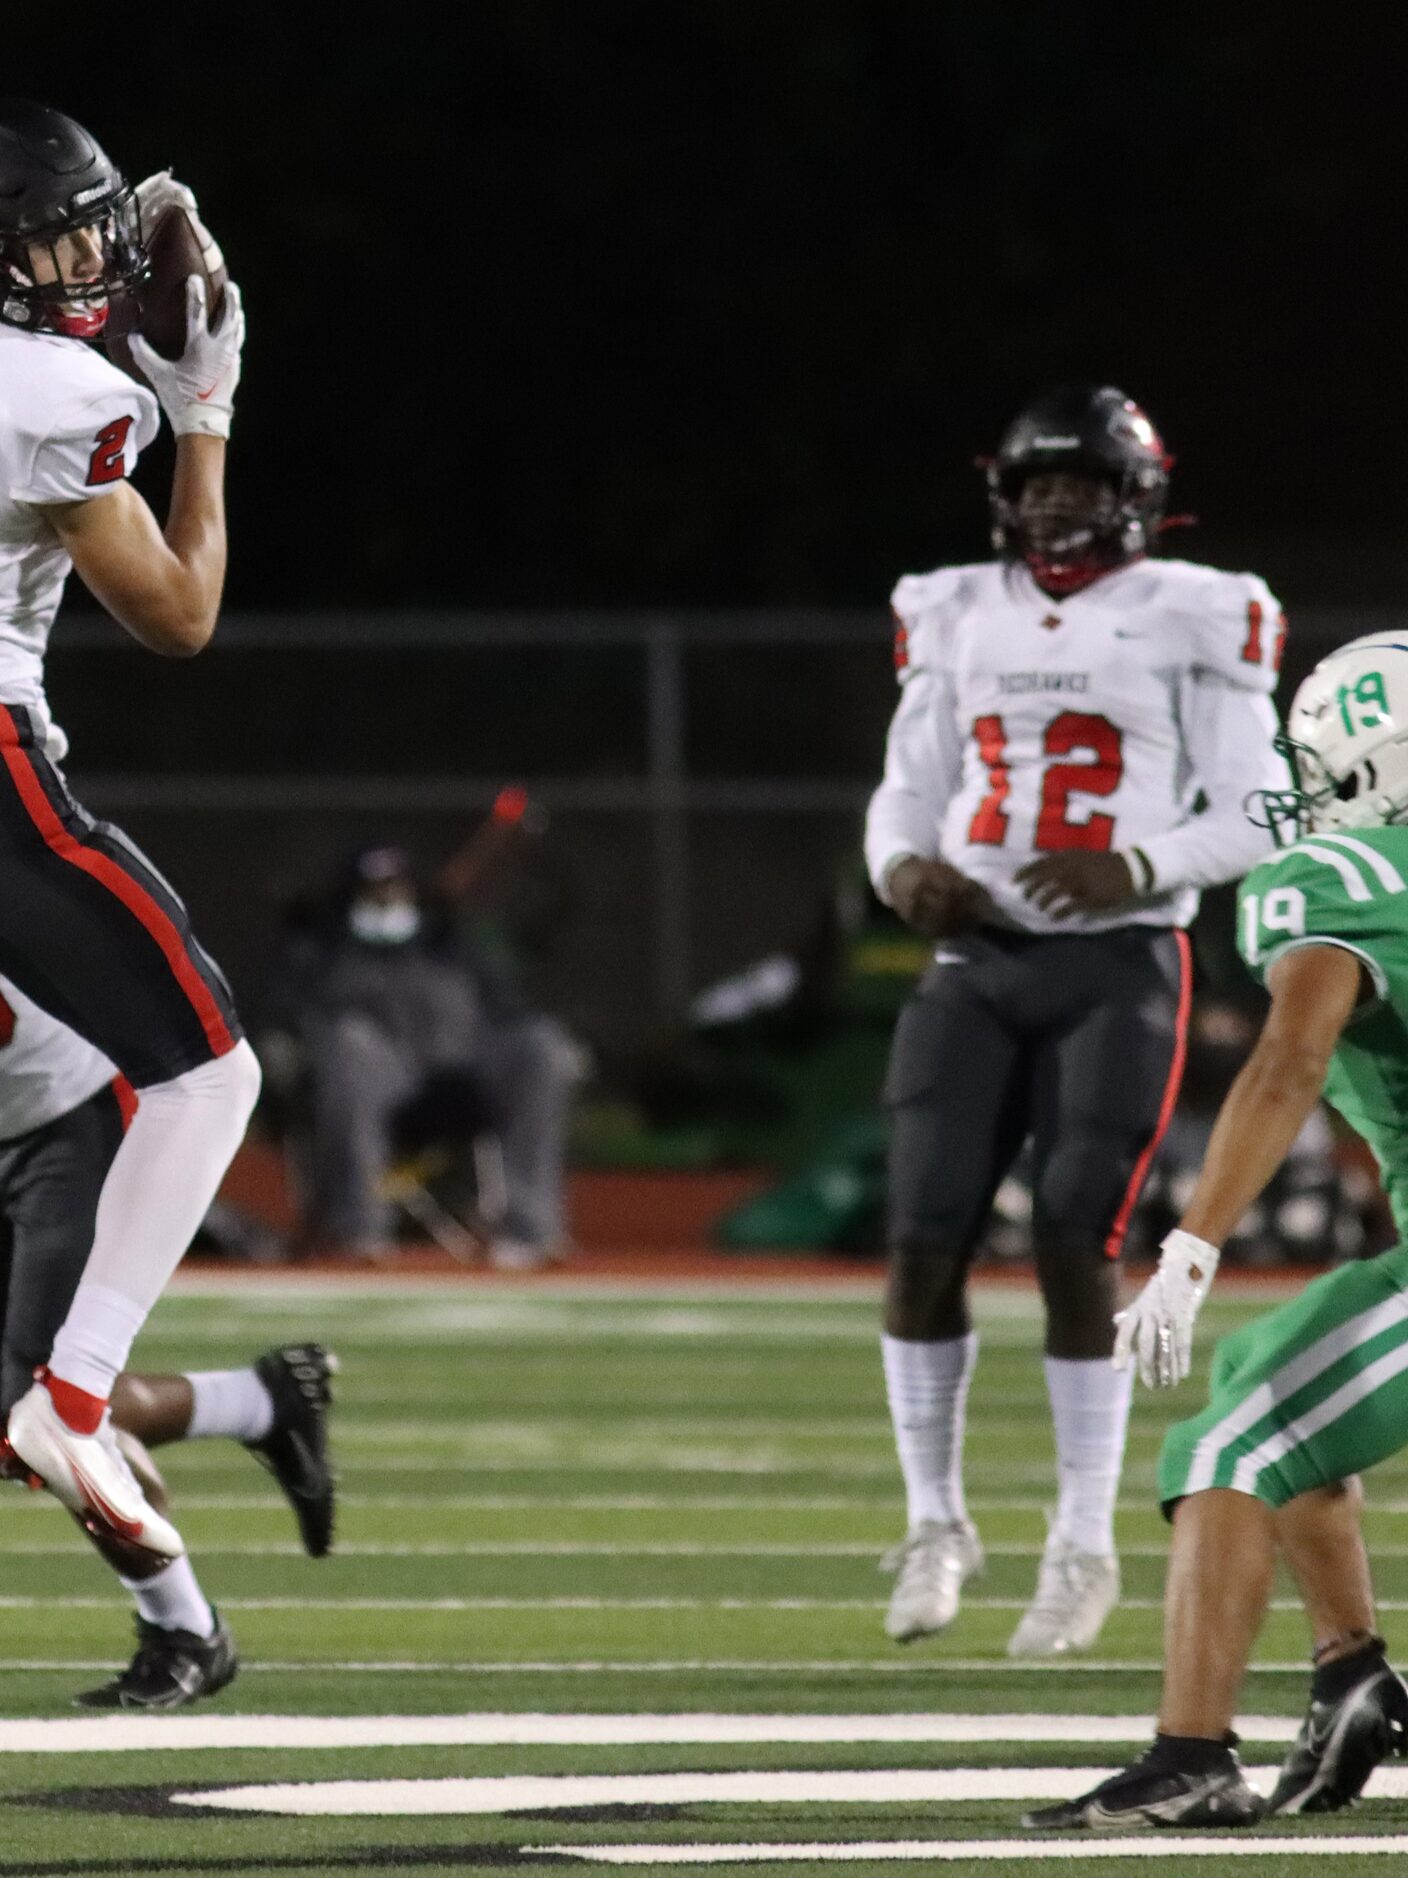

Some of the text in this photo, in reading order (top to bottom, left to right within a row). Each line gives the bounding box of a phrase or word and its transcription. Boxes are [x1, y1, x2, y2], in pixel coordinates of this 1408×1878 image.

[85, 414, 134, 486] 2
[1336, 670, 1390, 737] 19
[967, 711, 1123, 851] 12
[1244, 886, 1306, 966] 19
